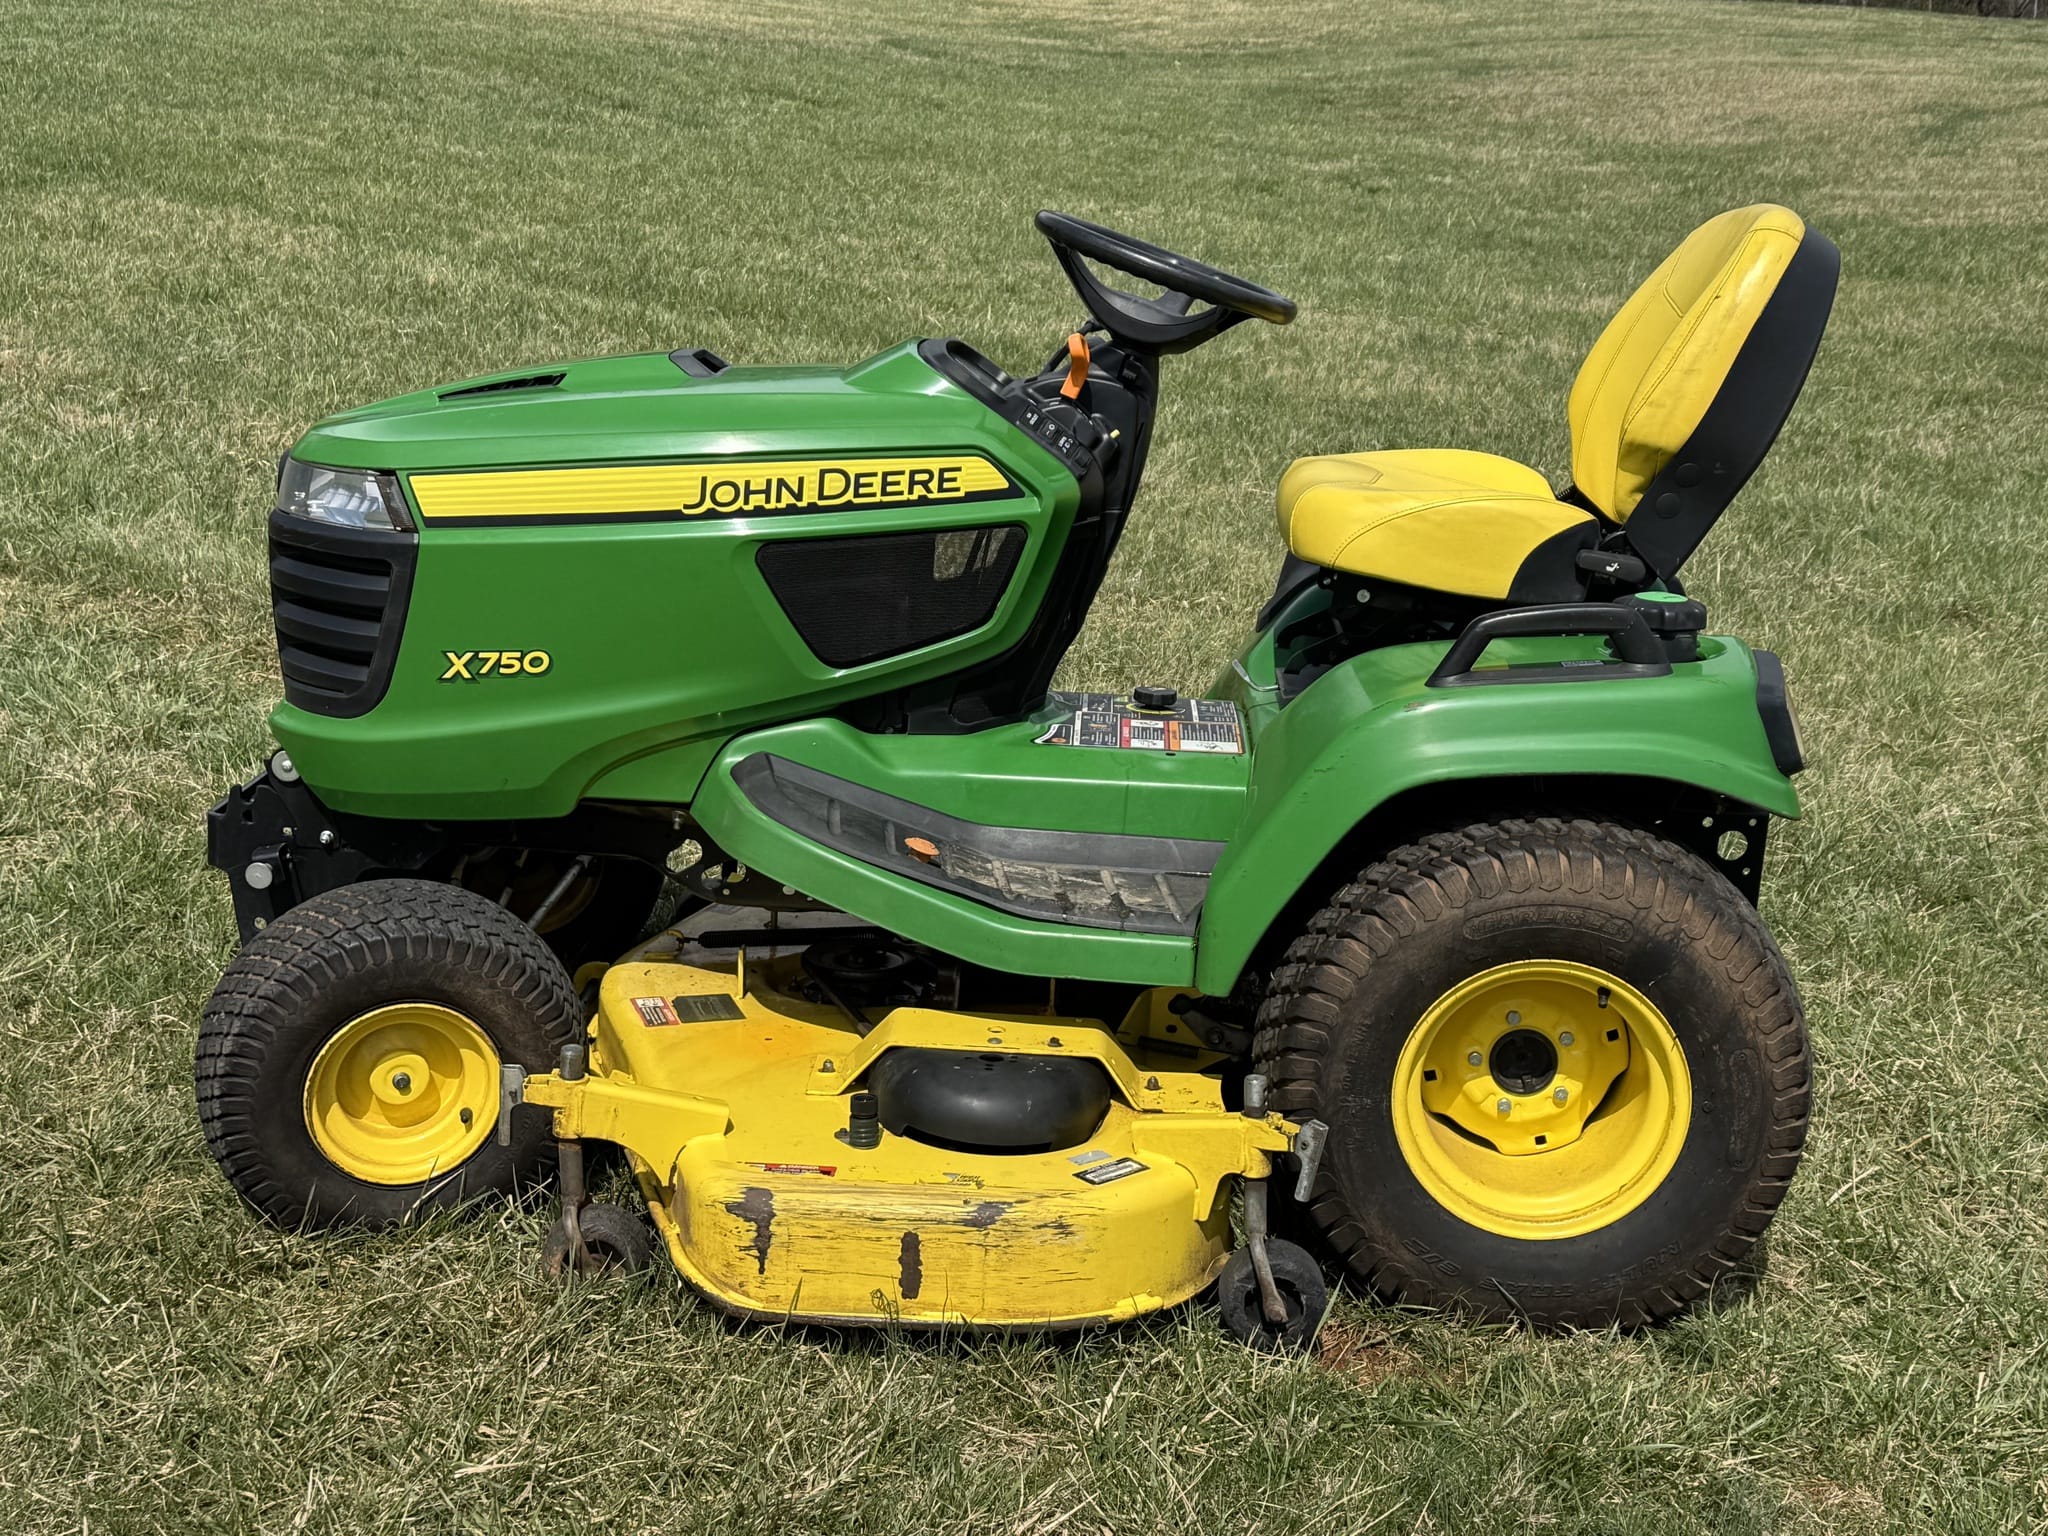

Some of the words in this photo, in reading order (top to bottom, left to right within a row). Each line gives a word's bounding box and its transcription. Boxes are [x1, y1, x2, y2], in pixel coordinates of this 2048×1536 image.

[683, 475, 805, 510] JOHN
[817, 466, 962, 502] DEERE
[439, 650, 551, 680] X750
